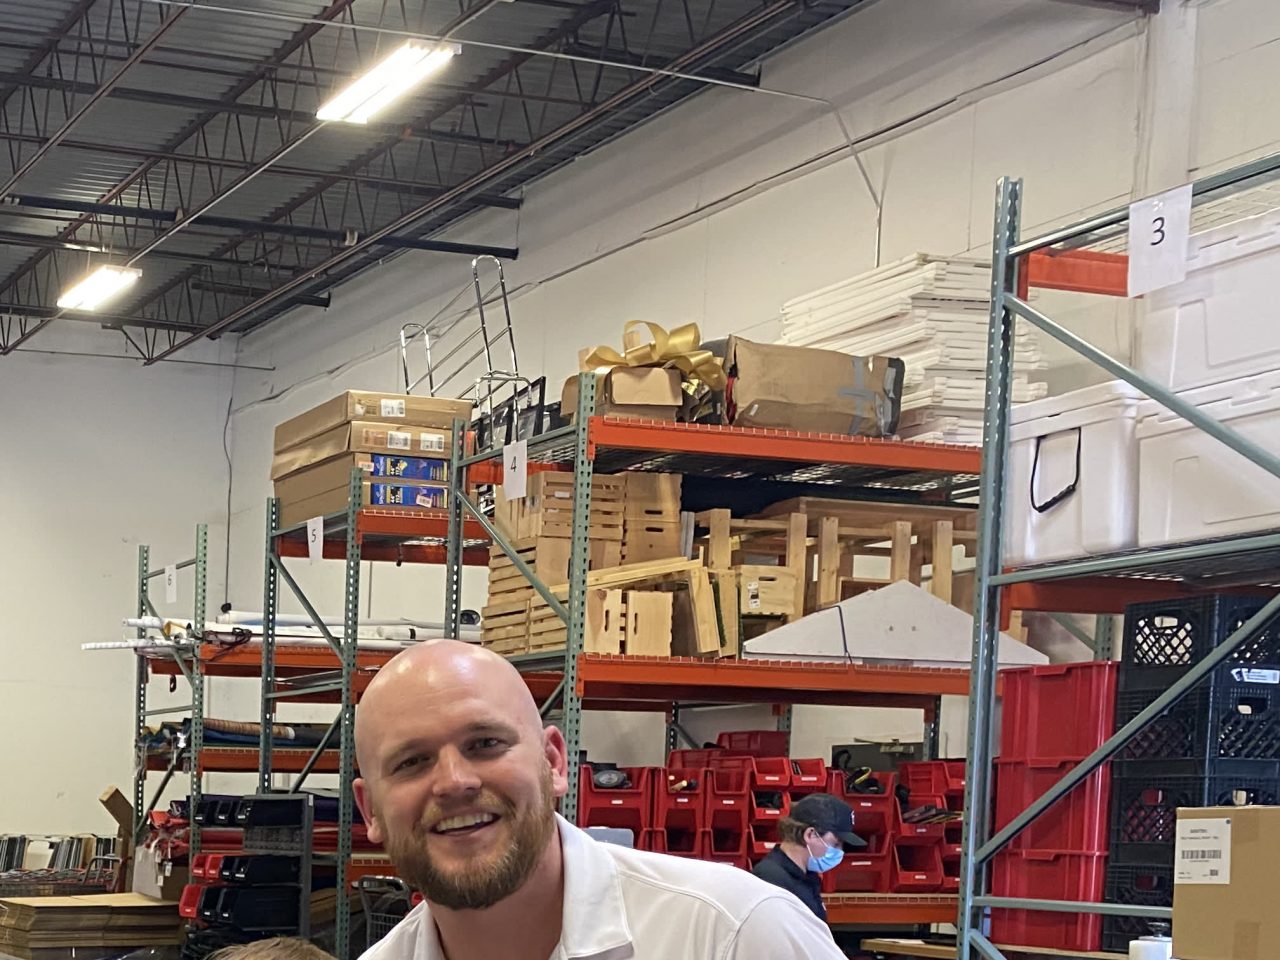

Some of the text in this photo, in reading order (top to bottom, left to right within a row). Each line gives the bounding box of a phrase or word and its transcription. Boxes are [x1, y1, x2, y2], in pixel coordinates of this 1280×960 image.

[1150, 216, 1166, 247] 3
[510, 455, 517, 472] 4
[311, 528, 317, 543] 5
